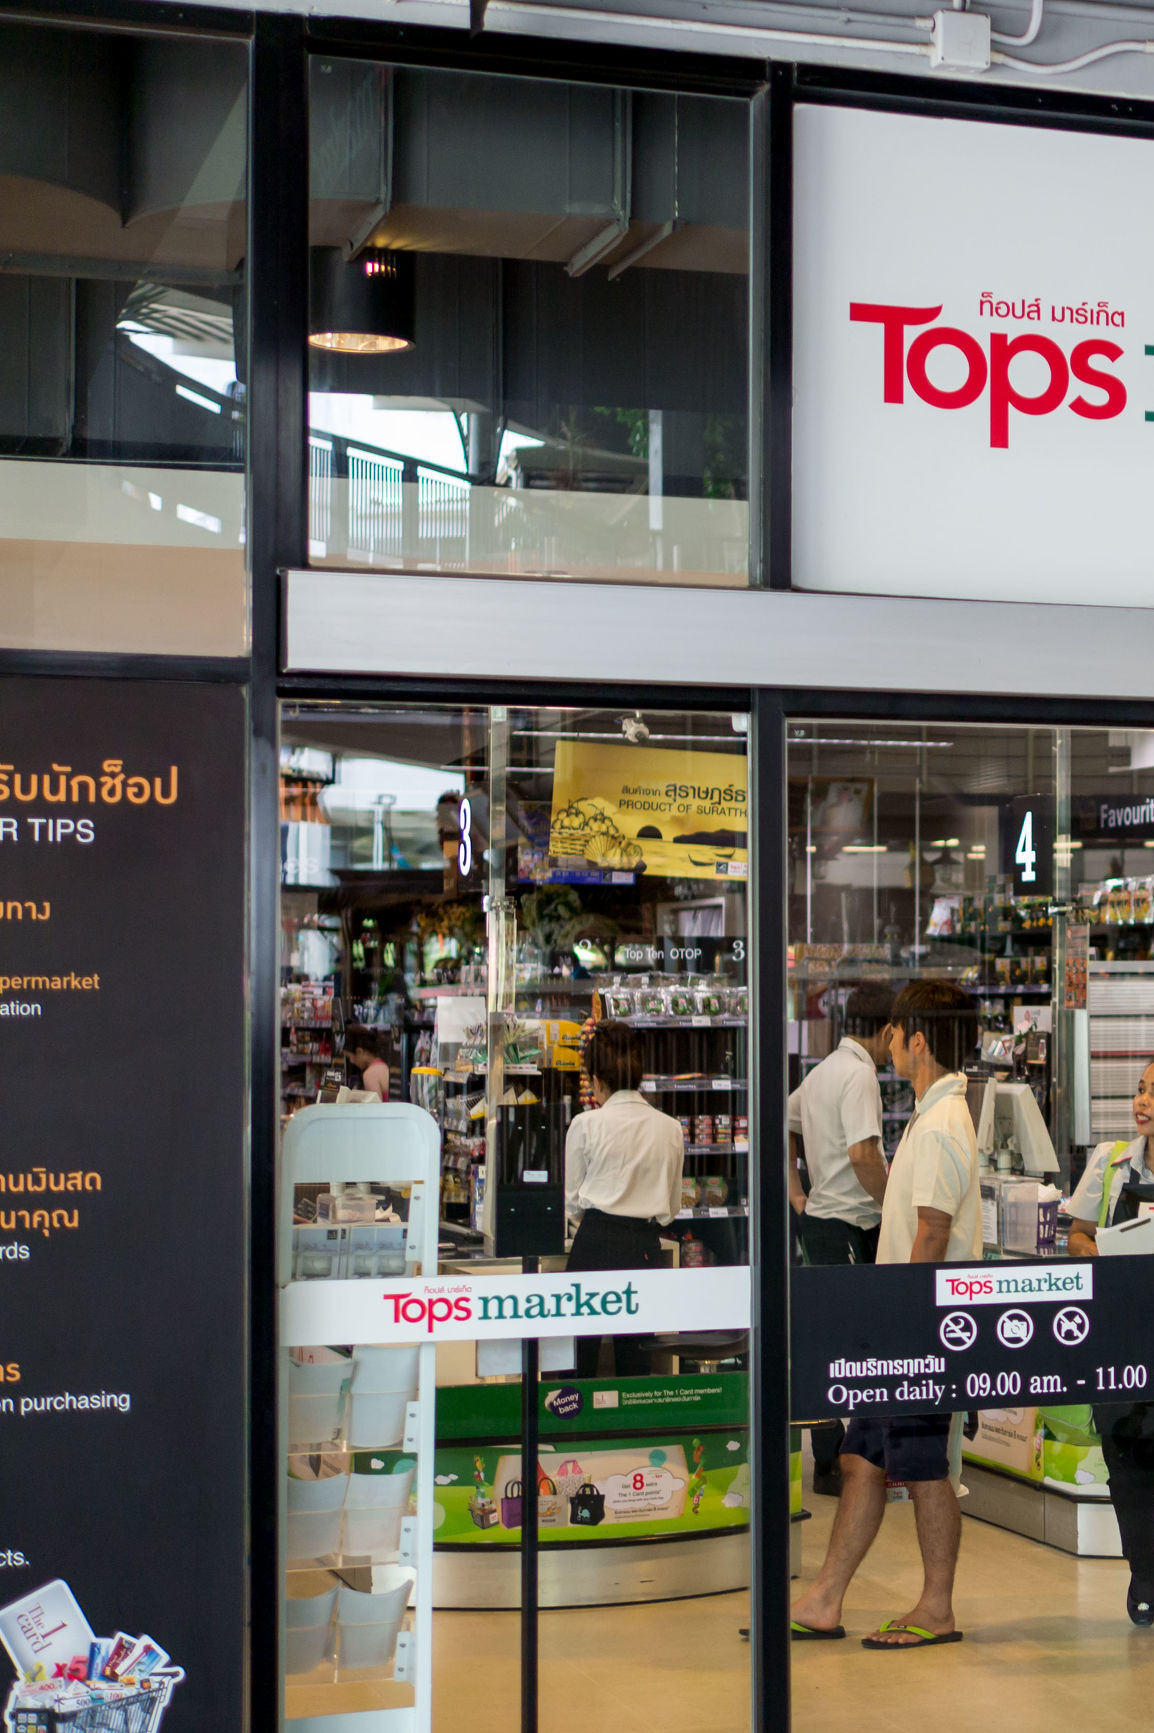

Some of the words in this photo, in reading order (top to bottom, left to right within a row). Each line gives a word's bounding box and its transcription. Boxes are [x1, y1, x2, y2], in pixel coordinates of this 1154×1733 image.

[979, 291, 1041, 321] ท็อปส์
[1051, 301, 1125, 329] มาร์เก็ต
[849, 301, 1128, 449] Tops
[618, 799, 673, 813] PRODUCT
[678, 803, 692, 814] OF
[28, 819, 95, 842] TIPS
[1015, 811, 1037, 882] 4
[670, 948, 702, 960] OTOP
[732, 940, 745, 961] 3
[946, 1277, 993, 1300] Tops
[996, 1272, 1084, 1294] market
[383, 1292, 472, 1333] Tops
[478, 1281, 639, 1320] market
[829, 1355, 945, 1378] เปิดบริการทุกวัน
[552, 1392, 579, 1407] Money
[827, 1383, 889, 1411] Open
[895, 1380, 946, 1406] daily
[966, 1372, 1021, 1398] 09.00
[1030, 1377, 1067, 1395] am.
[1096, 1365, 1147, 1391] 11.00
[20, 1391, 130, 1415] purchasing
[559, 1402, 579, 1415] back
[632, 1473, 645, 1491] 8
